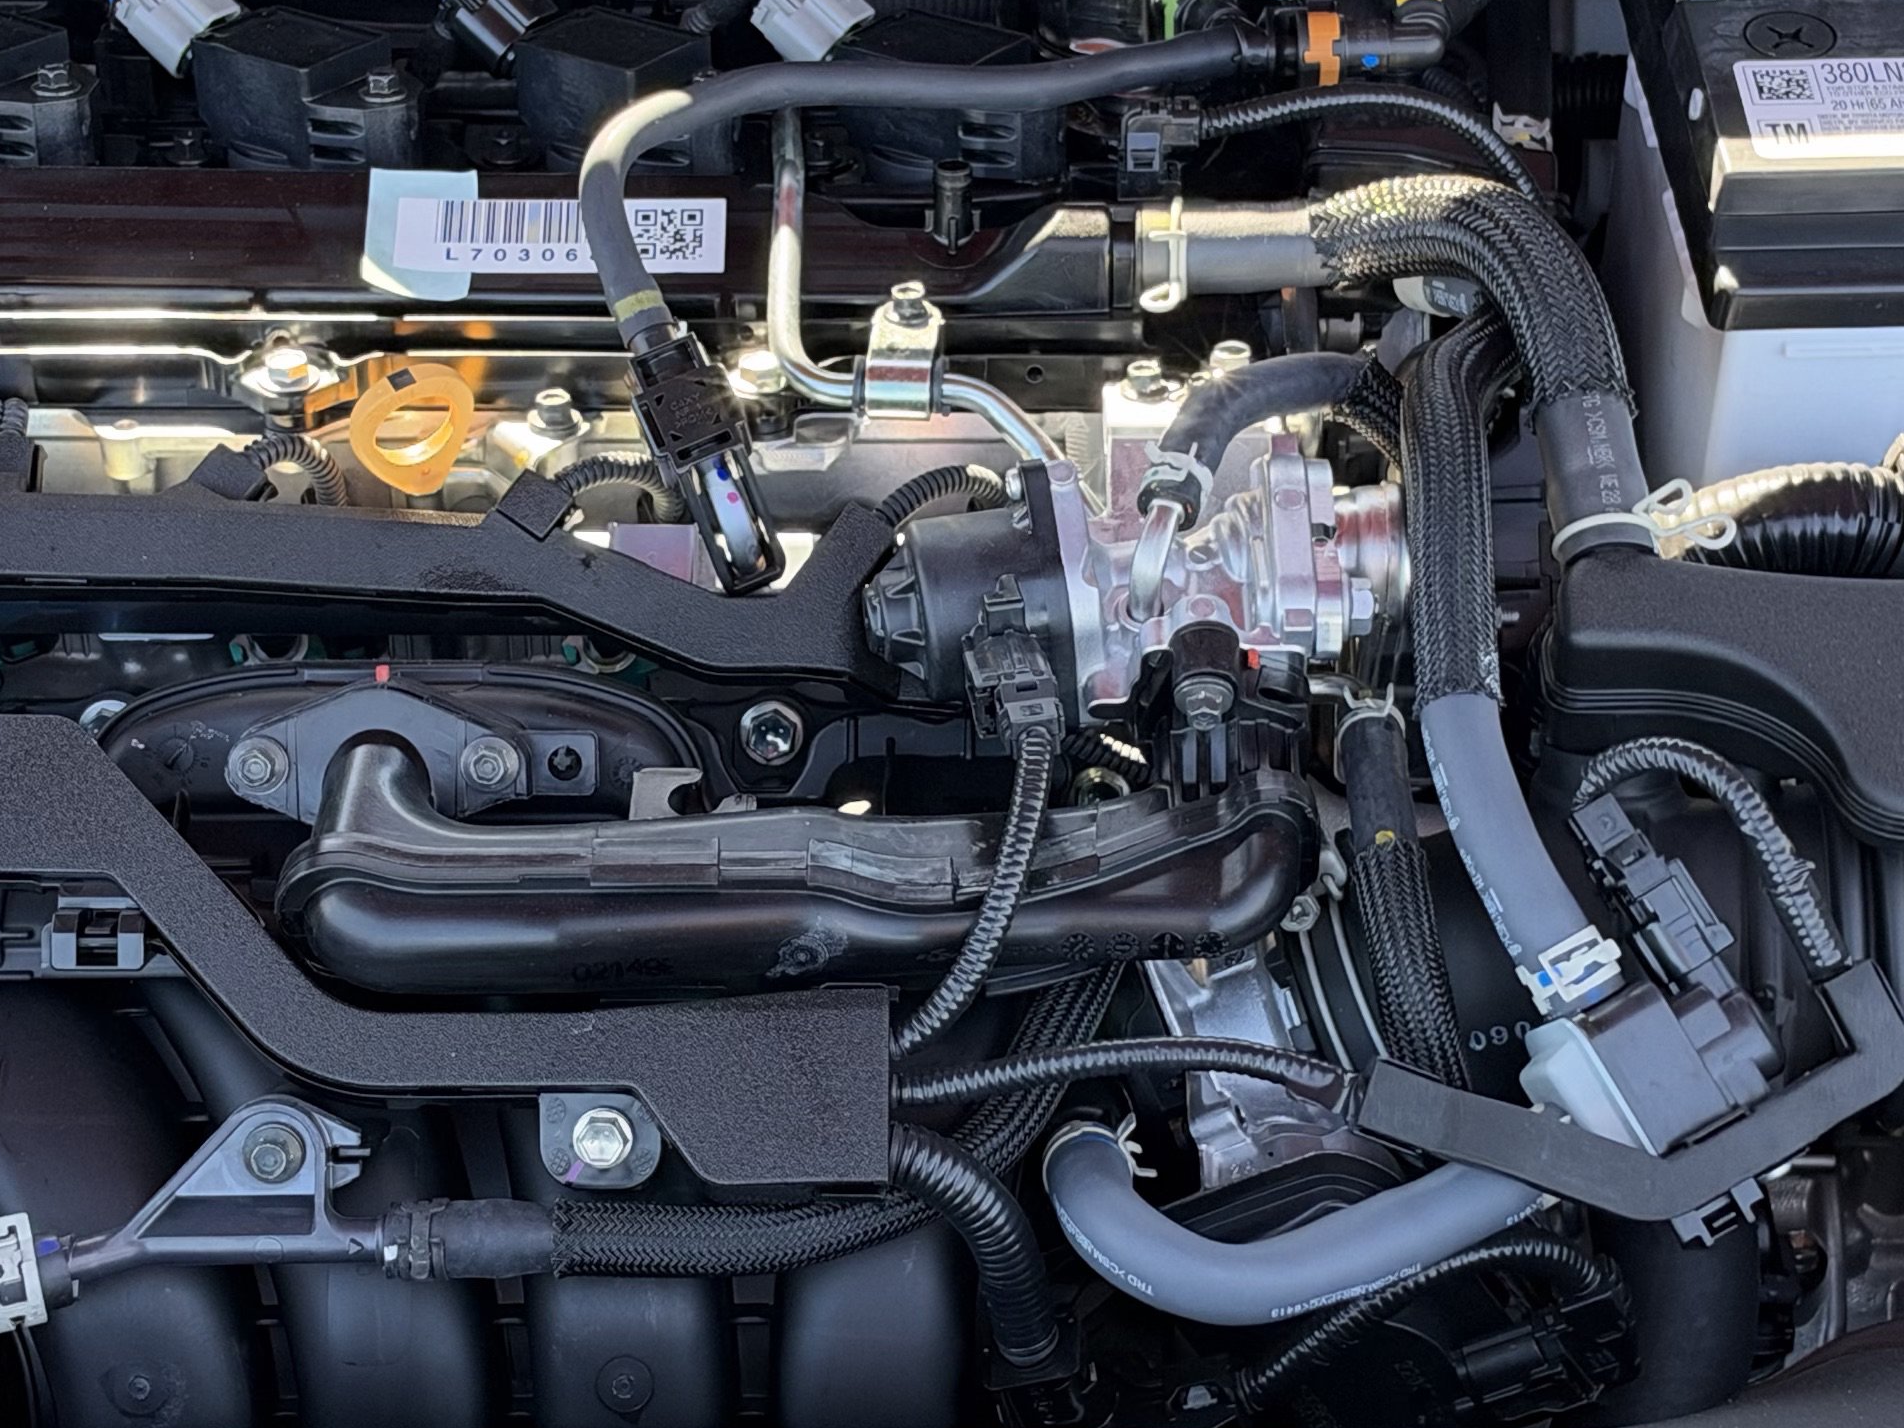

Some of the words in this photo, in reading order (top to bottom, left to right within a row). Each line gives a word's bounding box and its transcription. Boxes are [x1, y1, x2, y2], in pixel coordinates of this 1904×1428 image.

[1830, 99, 1848, 111] 20
[1849, 99, 1865, 110] Hr
[1869, 97, 1887, 110] 65
[1764, 122, 1811, 146] TM
[445, 246, 592, 262] L70306
